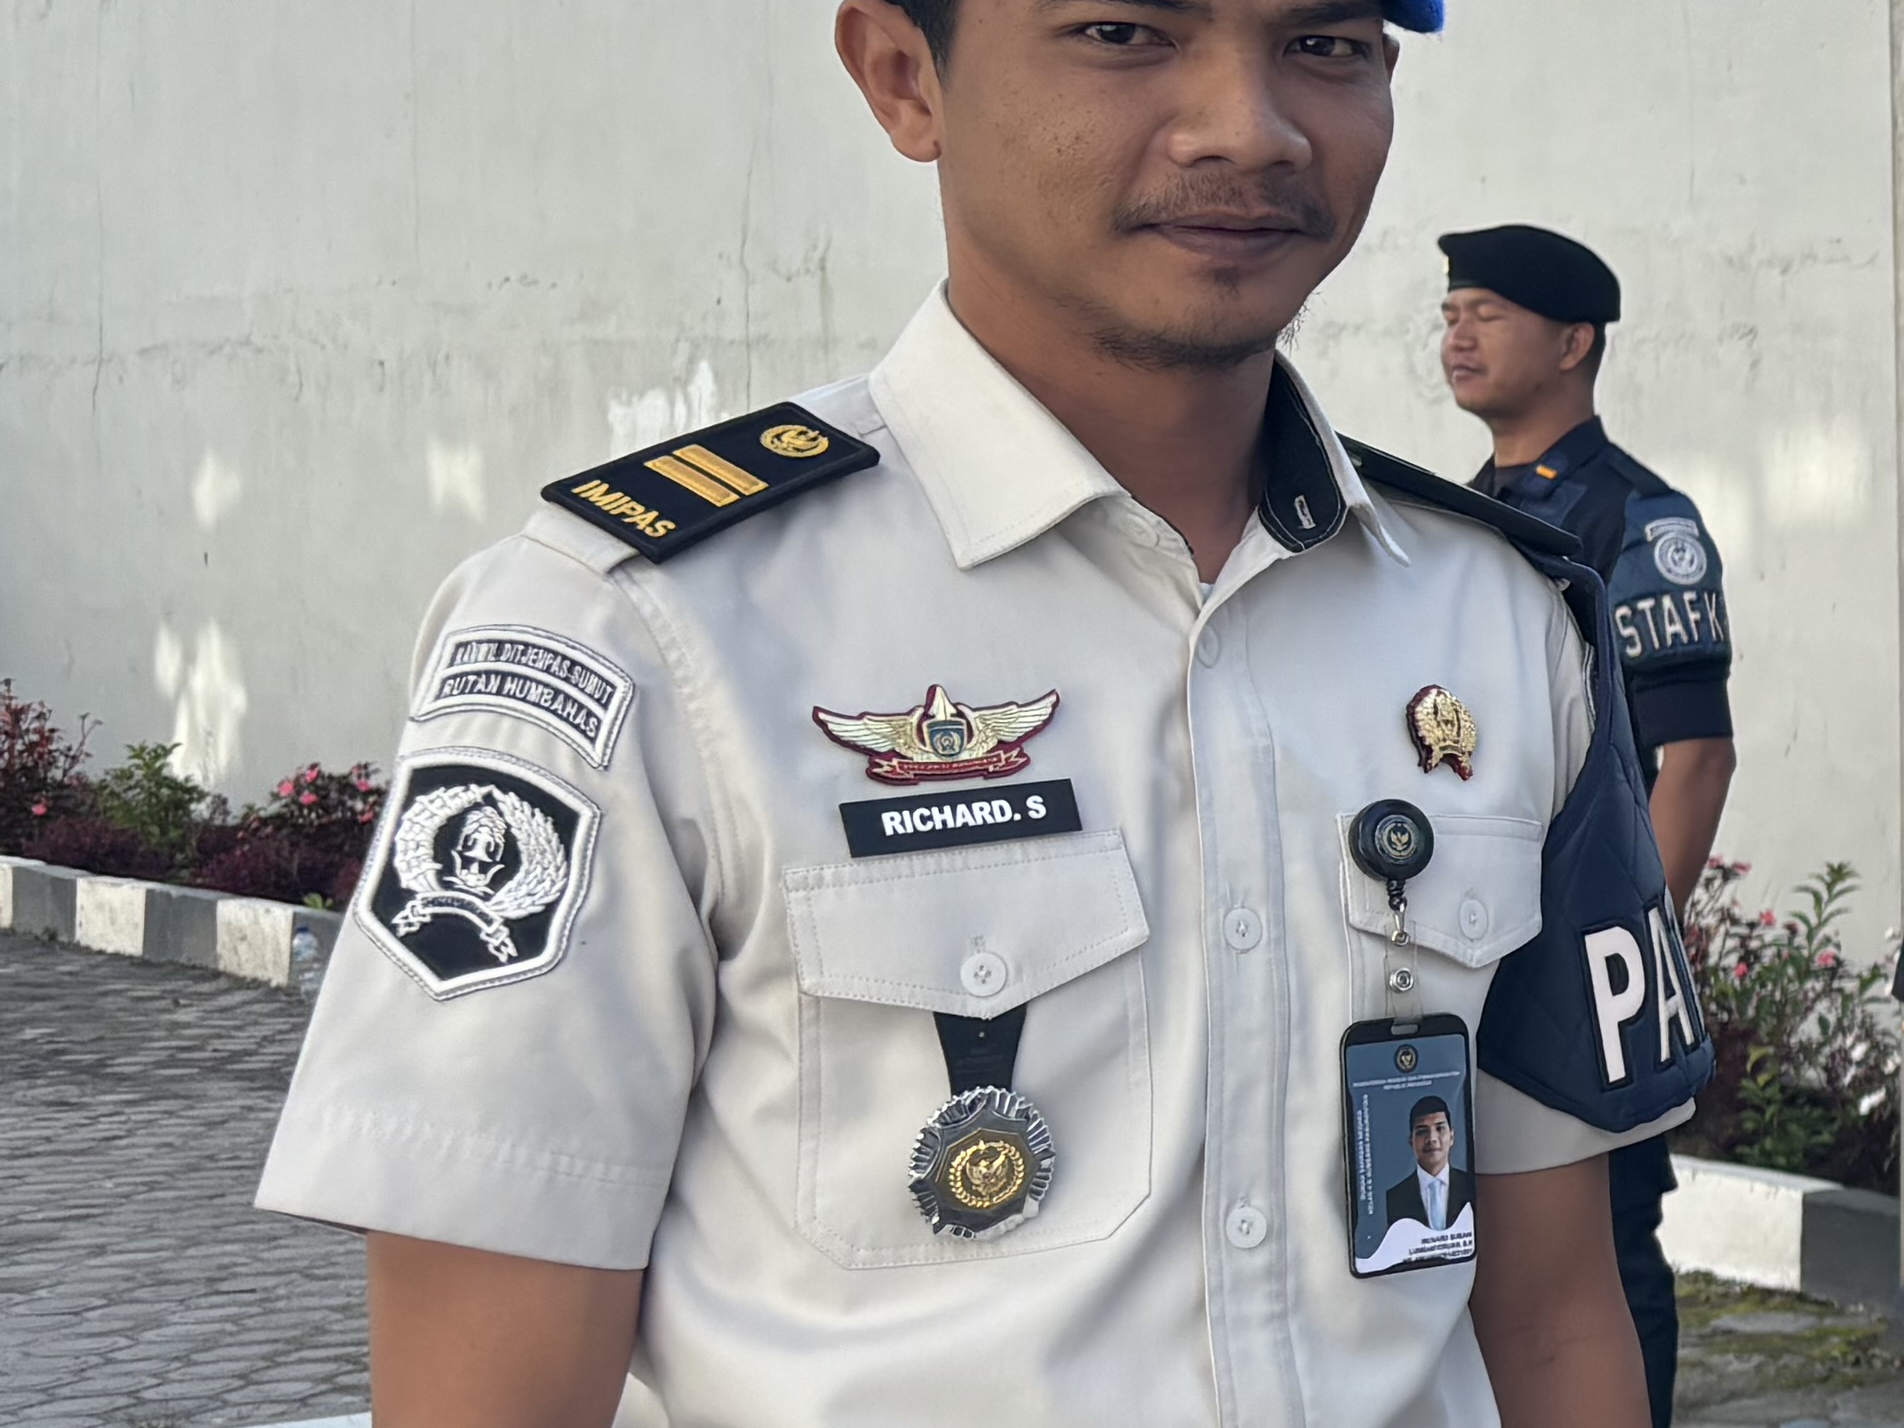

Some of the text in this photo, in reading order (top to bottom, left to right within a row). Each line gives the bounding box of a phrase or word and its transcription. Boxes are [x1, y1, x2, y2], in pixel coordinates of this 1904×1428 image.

[571, 480, 676, 538] IMIPAS
[441, 674, 502, 699] RUTAN
[881, 795, 1047, 836] RICHARD. S
